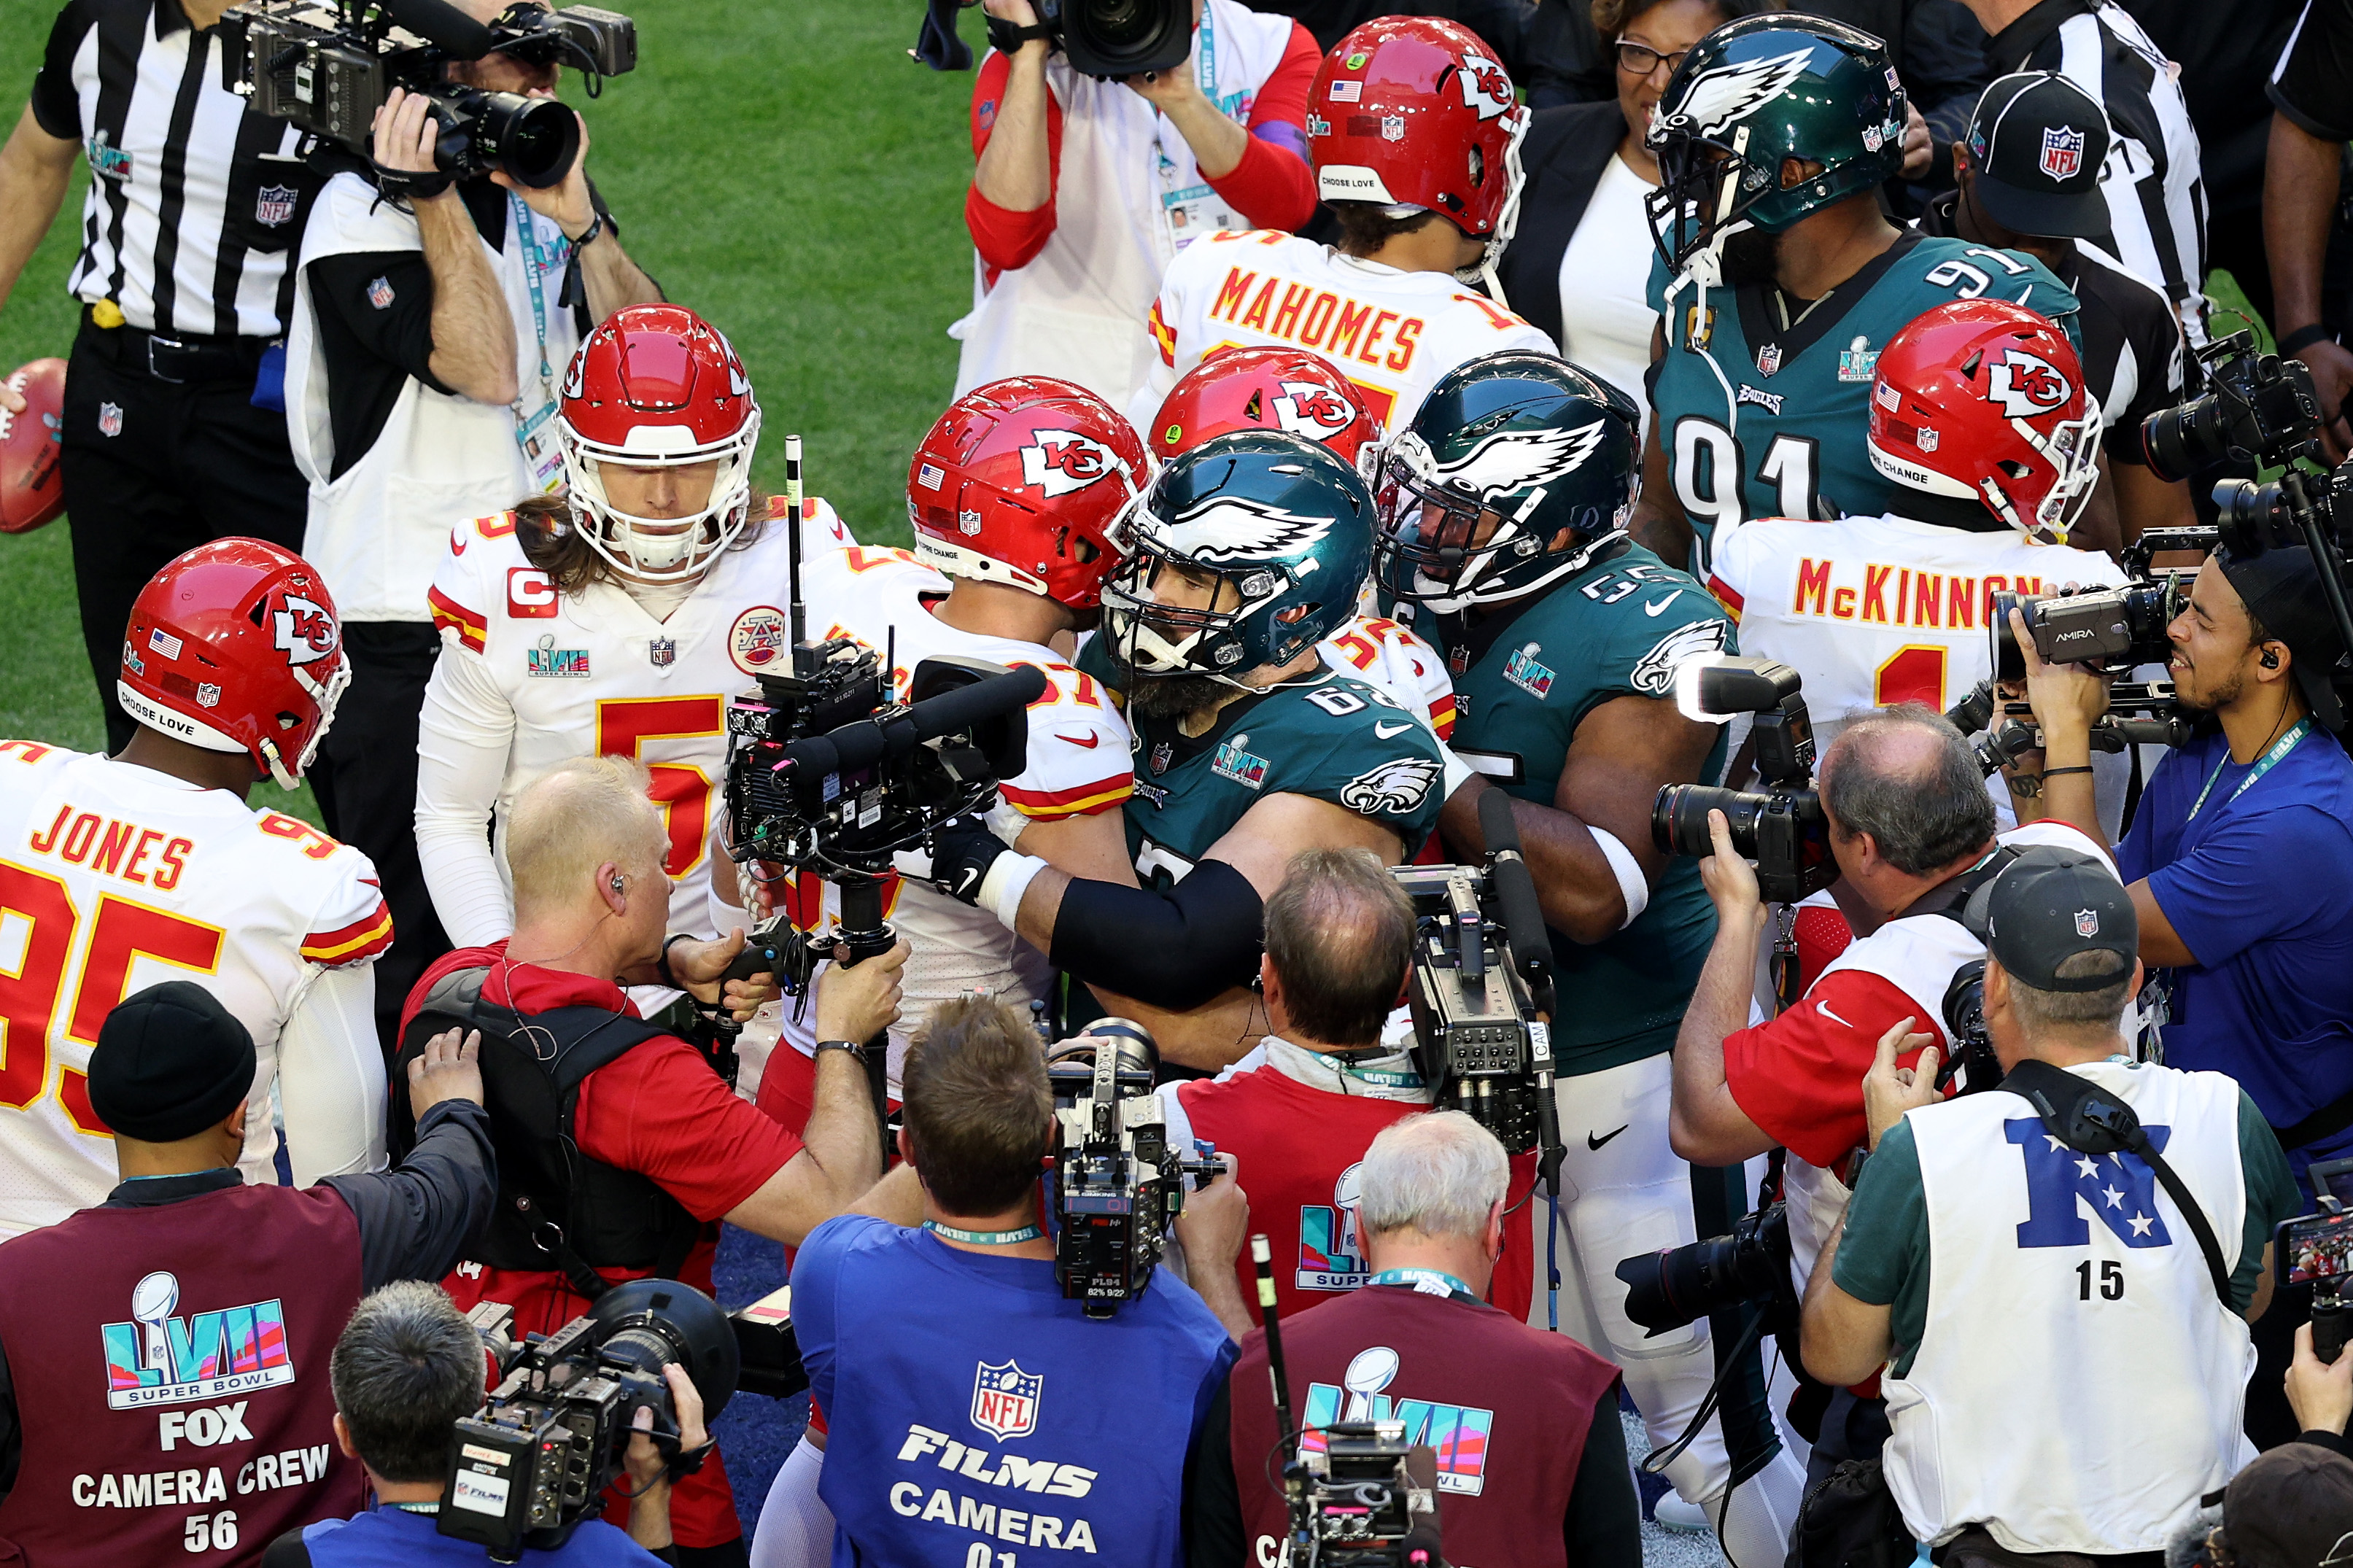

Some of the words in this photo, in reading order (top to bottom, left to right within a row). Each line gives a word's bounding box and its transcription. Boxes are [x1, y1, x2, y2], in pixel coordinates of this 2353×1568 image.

[1385, 126, 1400, 136] NFL
[1866, 136, 1881, 149] NFL
[2045, 149, 2077, 174] NFL
[1322, 176, 1350, 187] CHOOSE
[1352, 179, 1375, 188] LOVE
[261, 202, 290, 220] NFL
[1923, 247, 2036, 300] 91
[373, 288, 393, 306] NFL
[1209, 264, 1426, 375] MAHOMES
[1759, 354, 1778, 372] NFL
[1737, 384, 1784, 416] EAGLES
[102, 415, 120, 432] NFL
[1920, 438, 1934, 449] NFL
[1883, 460, 1928, 484] CHANGE
[1673, 415, 1820, 582] 91
[963, 521, 978, 532] NFL
[934, 548, 959, 559] CHANGE
[511, 570, 556, 606] C
[2055, 628, 2096, 643] AMIRA
[654, 651, 672, 664] NFL
[121, 691, 156, 721] CHOOSE
[159, 714, 195, 737] LOVE
[198, 693, 216, 705] NFL
[595, 692, 725, 882] 5
[1215, 766, 1236, 778] SUPER
[29, 803, 195, 893] JONES
[2079, 923, 2096, 933] NFL
[1532, 1024, 1548, 1057] CAM
[2003, 1117, 2174, 1249] N
[2075, 1260, 2125, 1301] 15
[128, 1385, 201, 1402] SUPER
[214, 1371, 274, 1392] BOWL
[978, 1390, 1028, 1429] NFL
[159, 1400, 255, 1452] FOX
[71, 1467, 228, 1509] CAMERA
[236, 1443, 330, 1495] CREW
[896, 1424, 1098, 1498] FILMS
[184, 1510, 239, 1553] 56
[889, 1480, 1098, 1554] CAMERA
